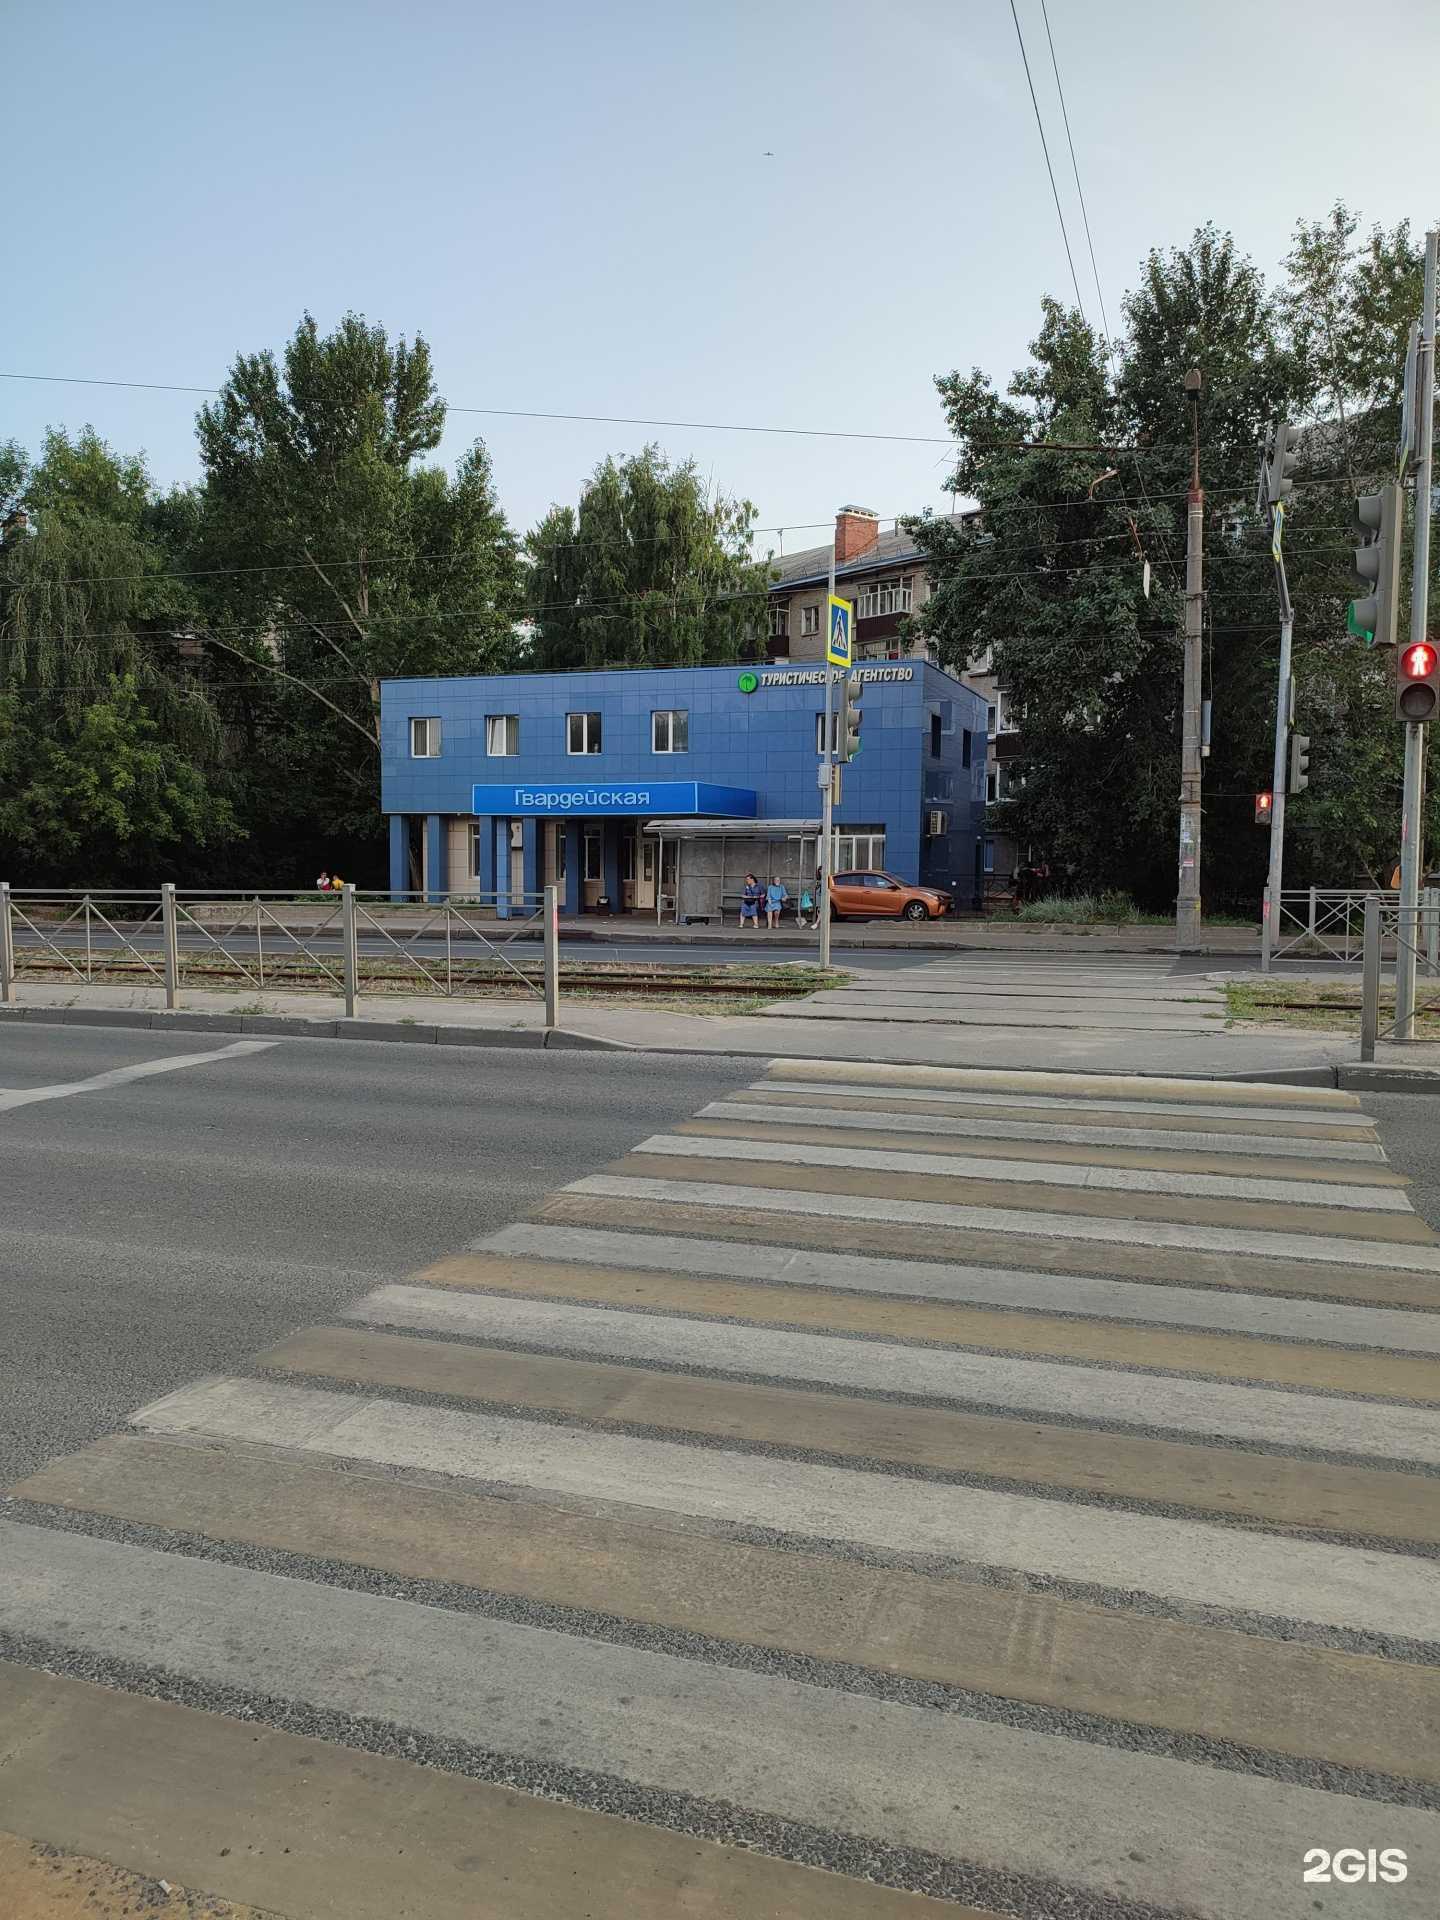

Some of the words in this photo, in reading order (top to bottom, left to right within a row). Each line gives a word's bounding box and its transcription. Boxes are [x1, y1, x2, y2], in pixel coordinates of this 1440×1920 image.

[761, 670, 846, 687] ТУРИСТИЧЕСОЕ
[850, 667, 913, 683] АГЕНТСТВО
[514, 789, 650, 809] Гвардейская
